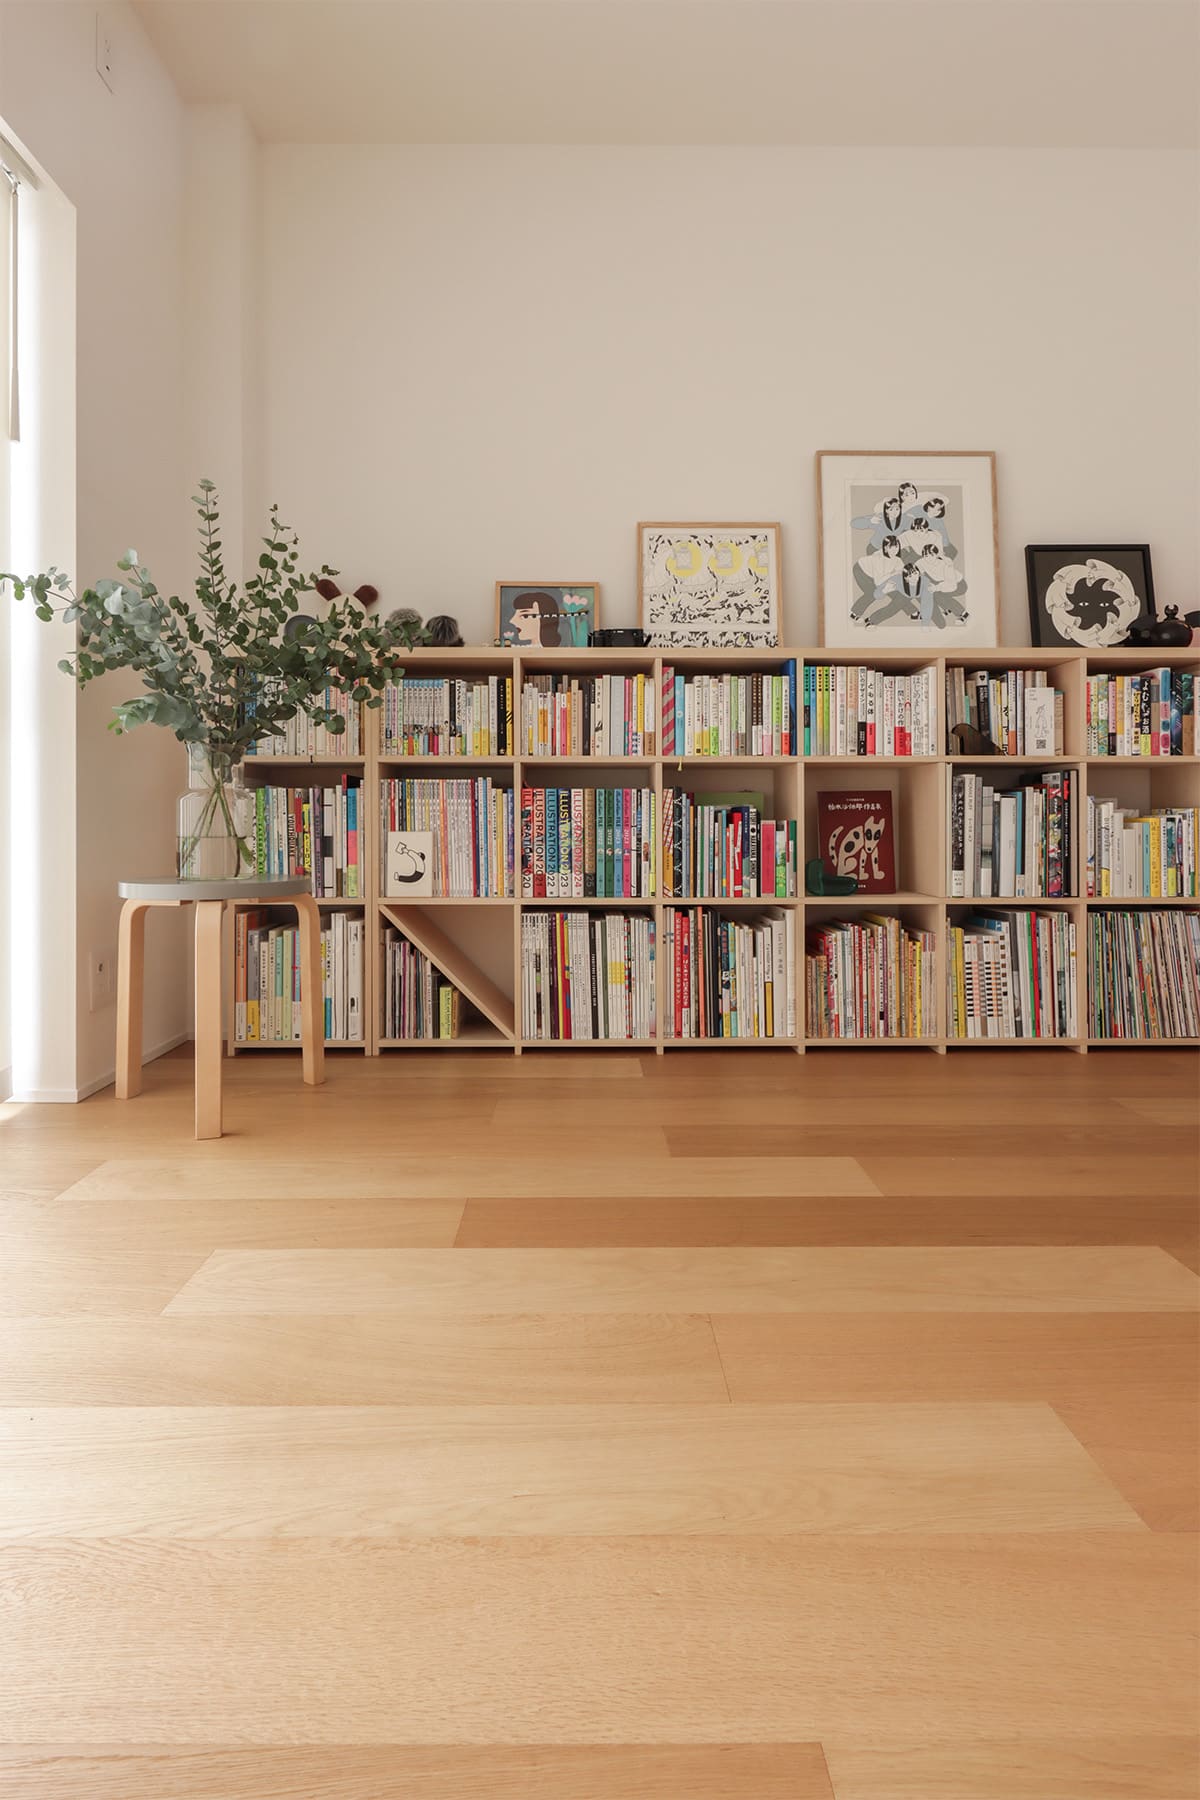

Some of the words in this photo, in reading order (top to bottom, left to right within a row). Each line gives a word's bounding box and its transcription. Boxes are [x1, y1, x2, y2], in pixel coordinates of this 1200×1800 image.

[523, 790, 533, 862] ILLUTRATION
[536, 790, 544, 862] ILLUSTRATION
[548, 790, 556, 862] ILLUSTRATION
[560, 790, 569, 862] ILLUSTRATION
[574, 790, 583, 862] ILLUSTRATION
[548, 863, 556, 888] 2022
[574, 863, 583, 888] 2024
